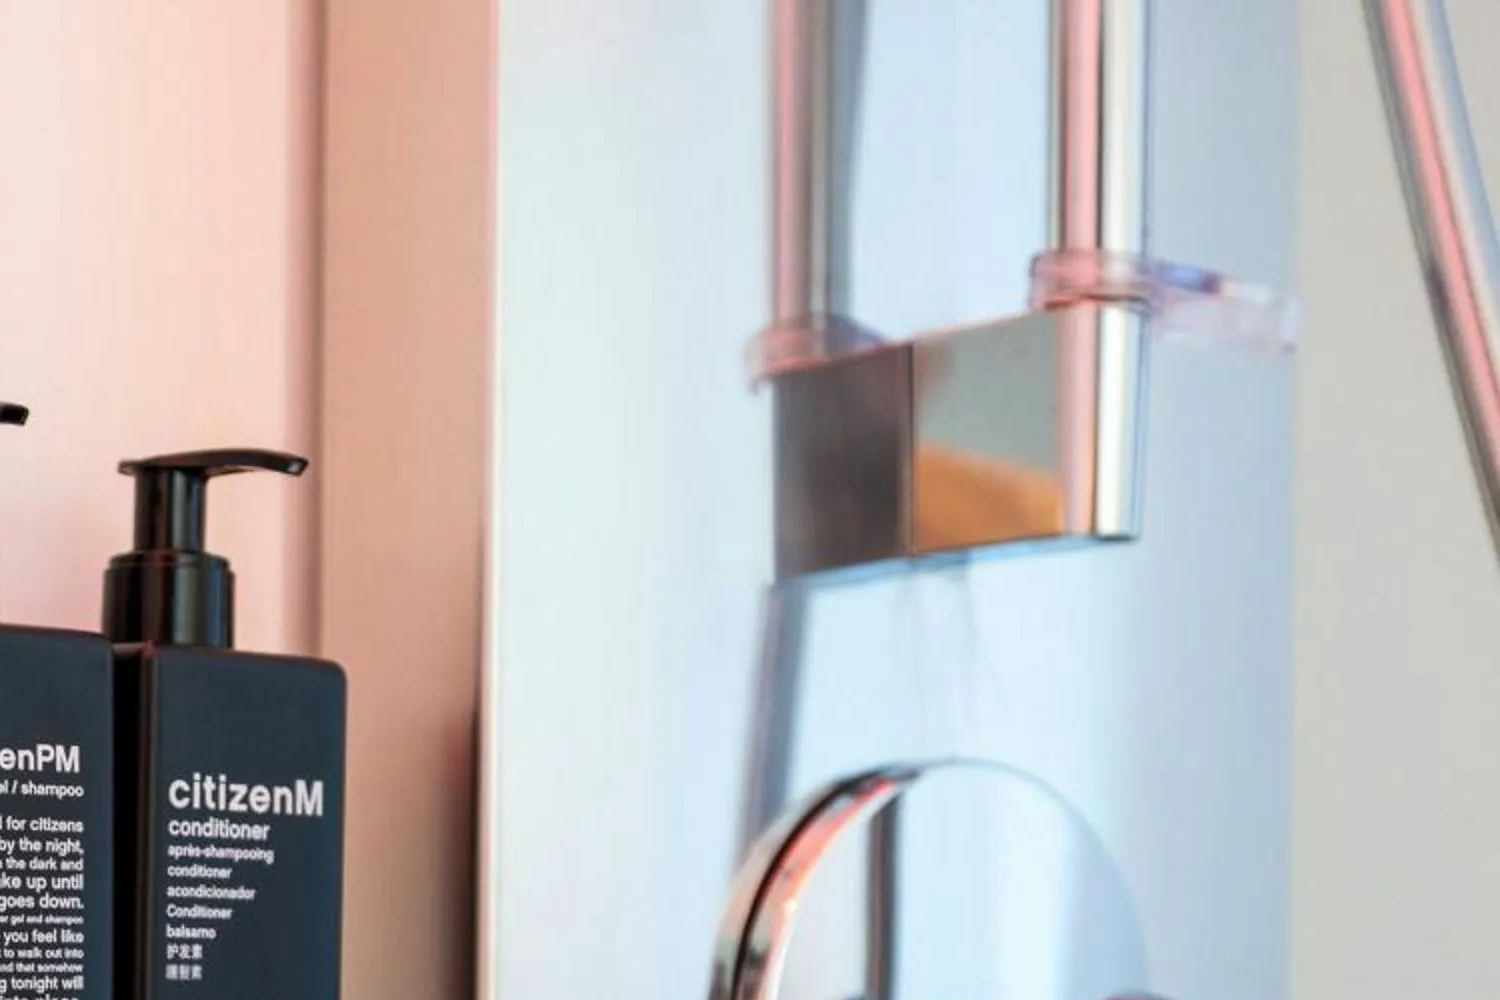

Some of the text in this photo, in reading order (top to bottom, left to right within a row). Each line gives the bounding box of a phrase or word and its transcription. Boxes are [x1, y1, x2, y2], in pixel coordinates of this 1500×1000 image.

[11, 780, 18, 794] /
[20, 780, 84, 799] shampoo
[168, 772, 323, 816] citizenM
[5, 815, 27, 830] for
[29, 817, 84, 832] citizens
[168, 817, 270, 840] conditioner
[18, 836, 42, 852] the
[45, 838, 84, 856] night,
[5, 856, 26, 870] the
[29, 856, 57, 870] dark
[60, 858, 84, 871] and
[168, 864, 232, 879] conditioner
[26, 876, 47, 893] up
[51, 873, 84, 890] until
[167, 885, 256, 900] acondicionador
[39, 893, 84, 909] down.
[166, 904, 232, 919] Conditioner
[3, 931, 28, 946] you
[31, 928, 57, 942] feel
[61, 928, 84, 943] like
[166, 923, 216, 939] balsamo
[17, 947, 43, 958] walk
[45, 948, 62, 958] out
[64, 948, 84, 959] into
[15, 962, 35, 973] that
[11, 976, 58, 993] tonight
[61, 976, 84, 990] will
